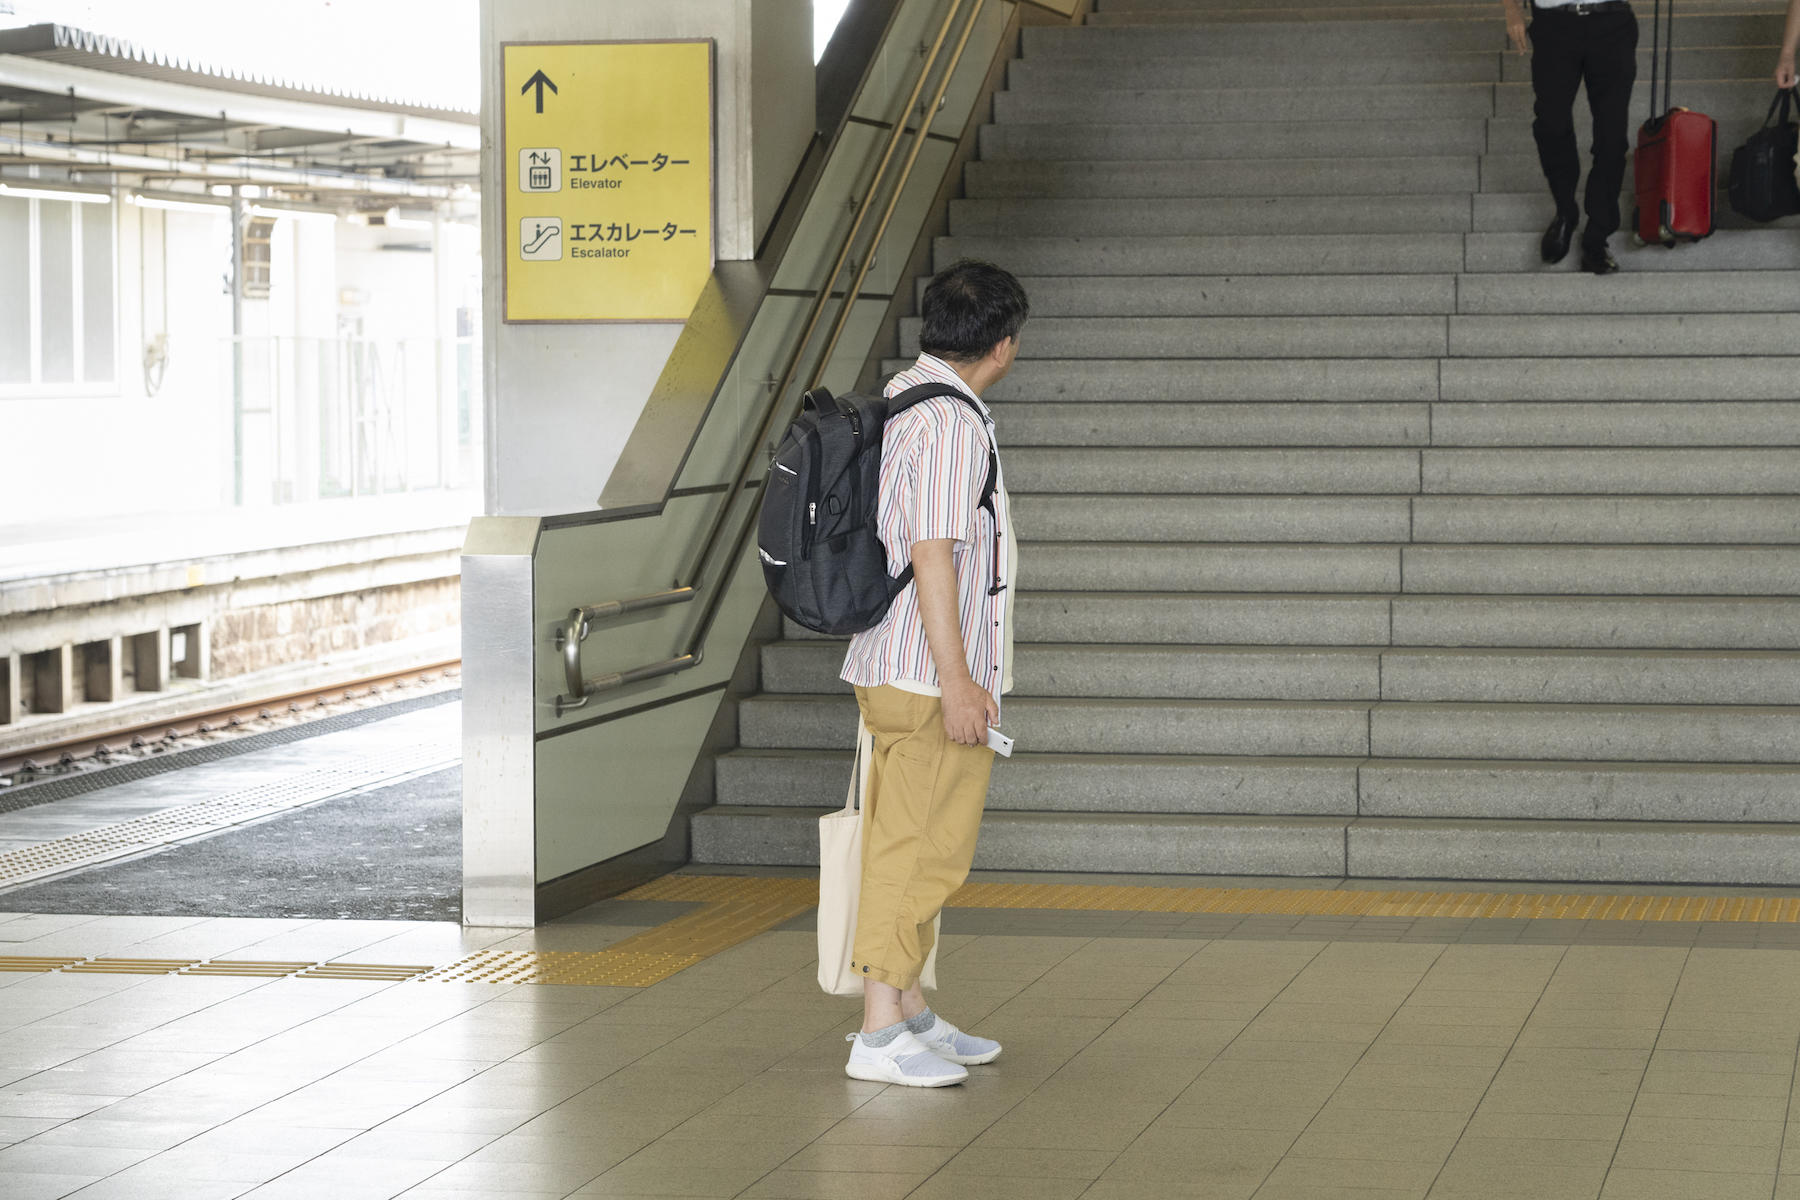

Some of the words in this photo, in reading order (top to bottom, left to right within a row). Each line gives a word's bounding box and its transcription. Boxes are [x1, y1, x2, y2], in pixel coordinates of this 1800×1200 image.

[570, 153, 690, 173] エレベーター
[570, 178, 622, 189] Elevator
[570, 222, 697, 242] エスカレーター
[571, 247, 631, 258] Escalator
